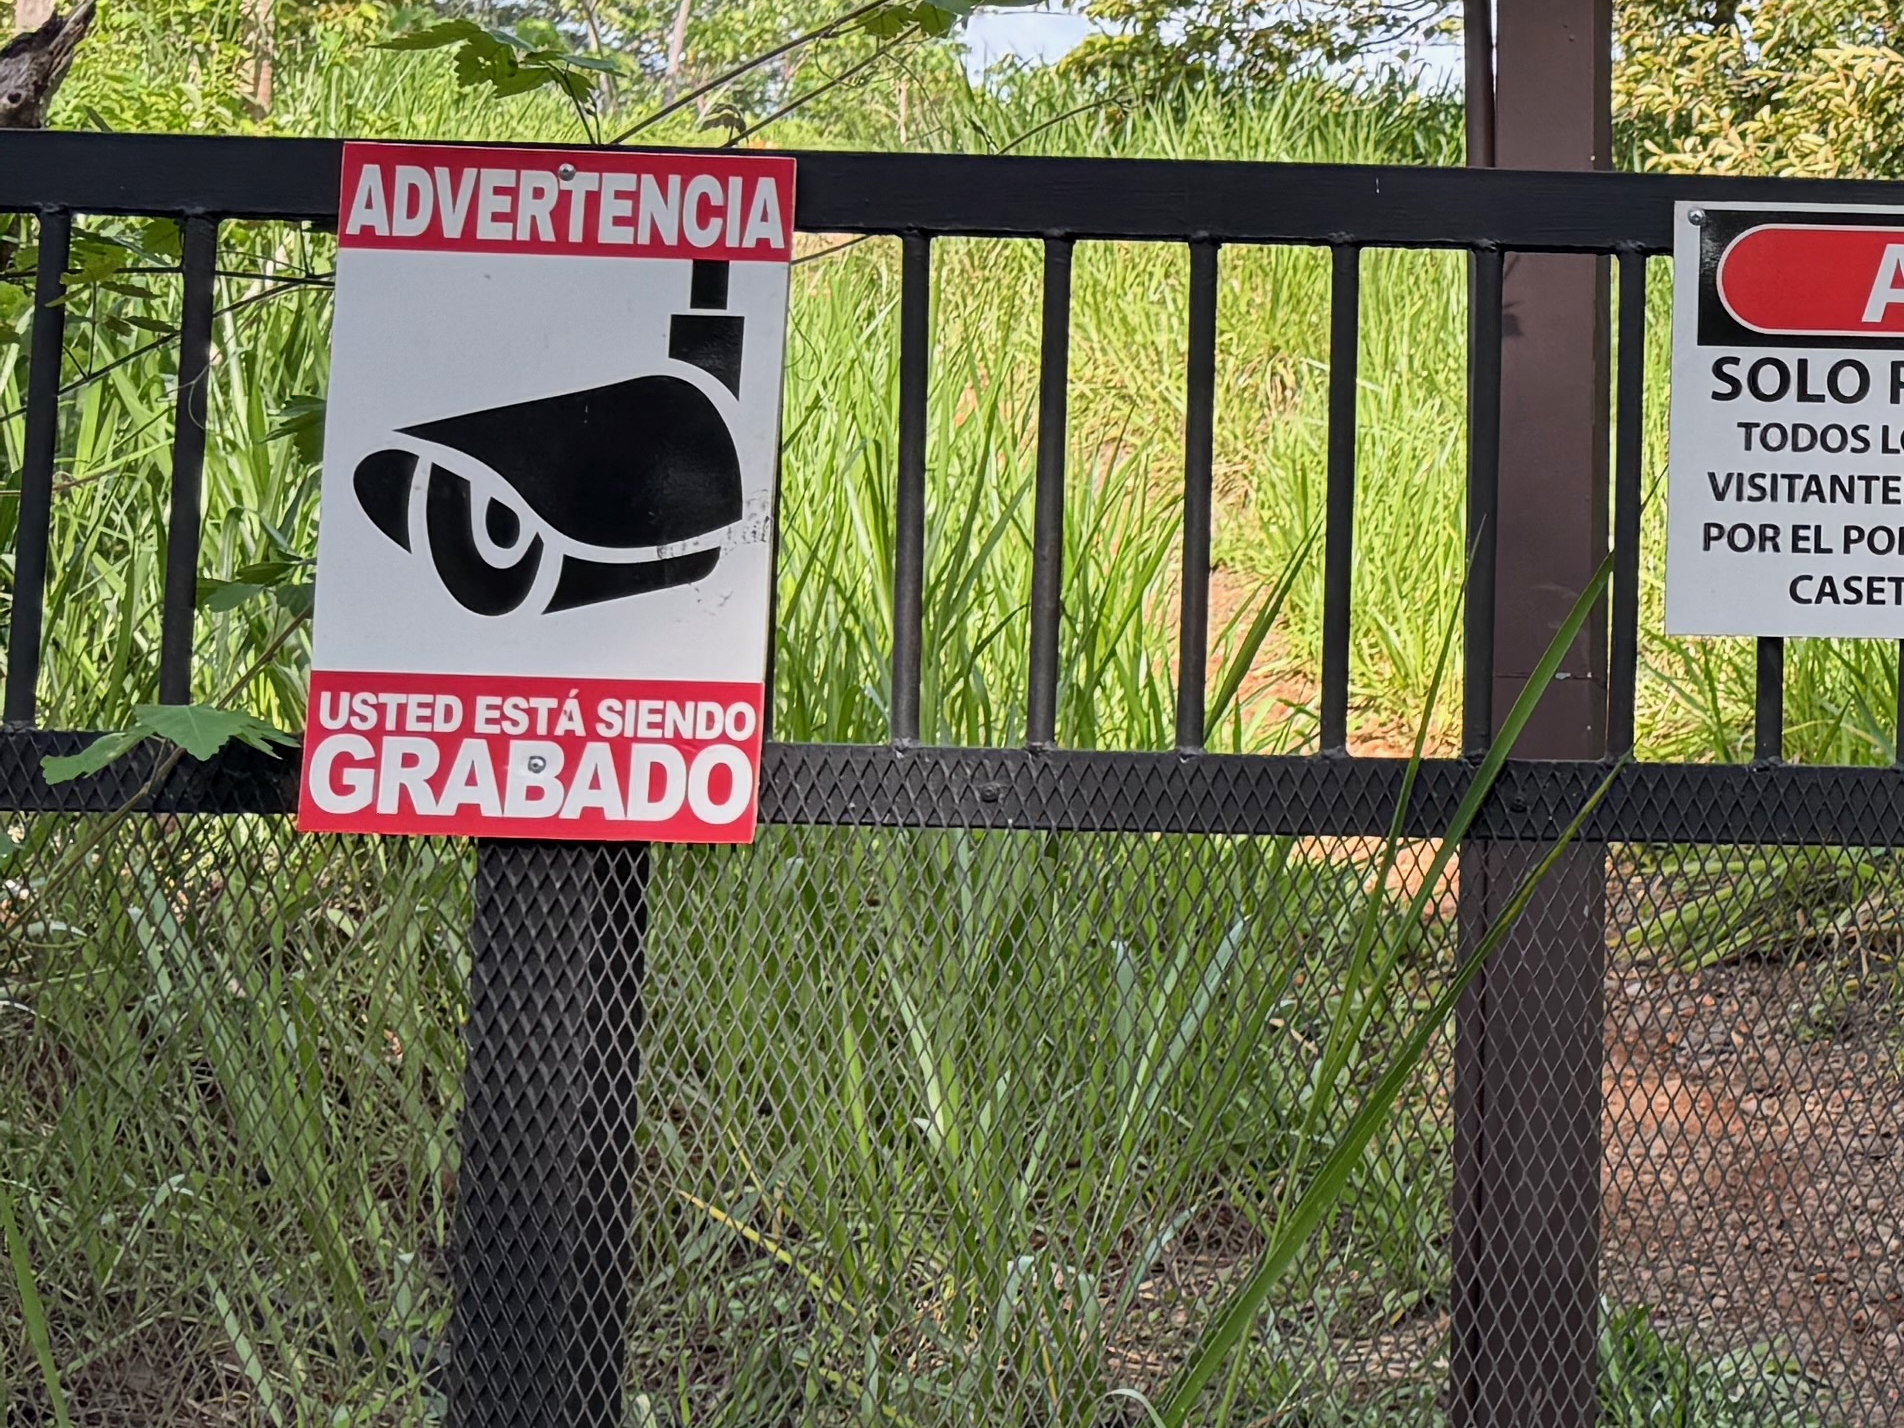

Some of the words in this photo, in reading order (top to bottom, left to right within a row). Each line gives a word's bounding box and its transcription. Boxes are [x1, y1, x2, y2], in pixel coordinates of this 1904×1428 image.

[346, 164, 784, 248] ADVERTENCIA
[1712, 356, 1870, 404] SOLO
[1737, 422, 1870, 453] TODOS
[1703, 523, 1780, 552] POR
[1792, 525, 1833, 553] EL
[320, 692, 463, 732] USTED
[474, 689, 586, 736] ESTÁ
[596, 699, 756, 741] SIENDO
[309, 734, 753, 824] GRABADO
